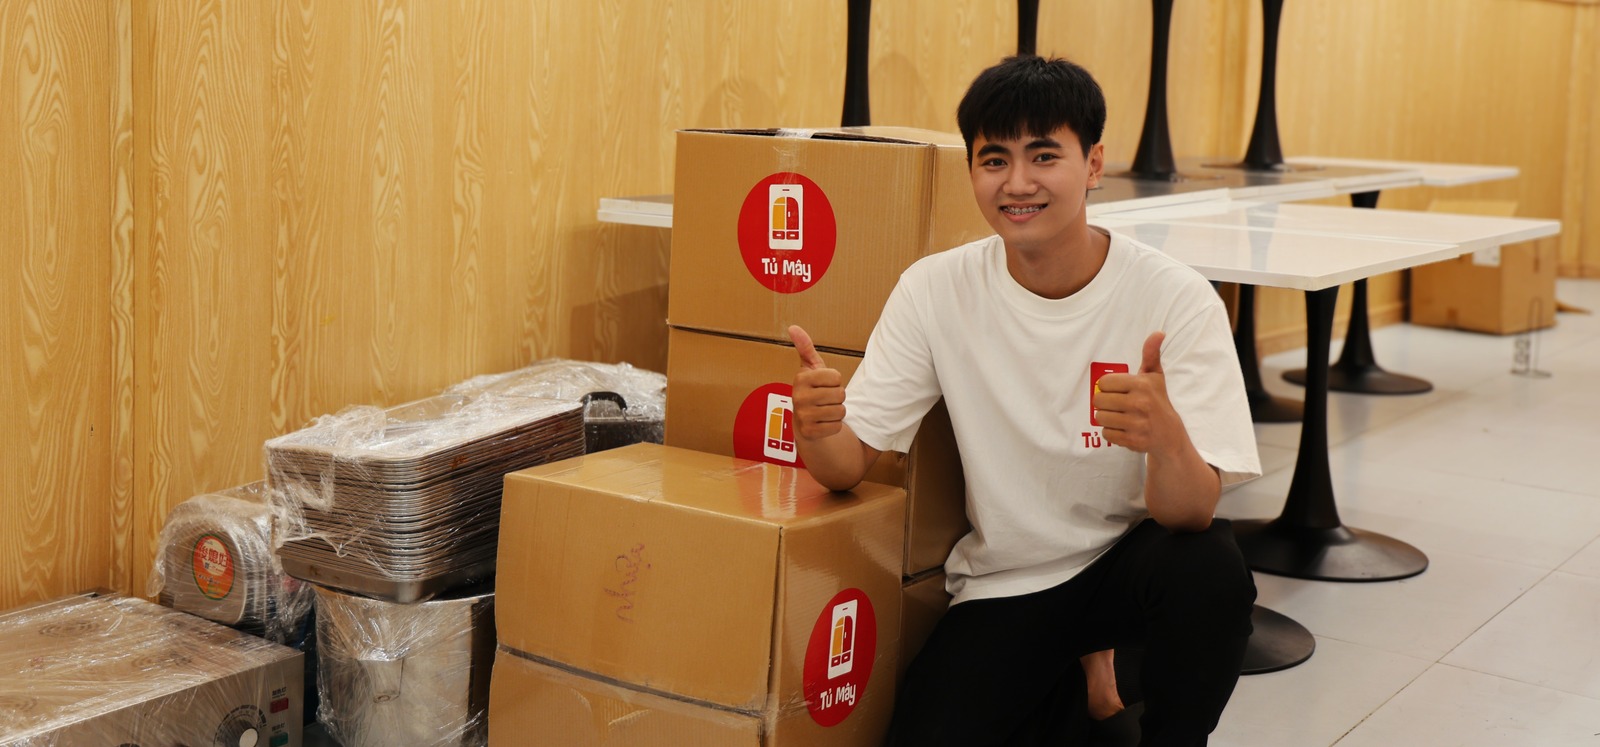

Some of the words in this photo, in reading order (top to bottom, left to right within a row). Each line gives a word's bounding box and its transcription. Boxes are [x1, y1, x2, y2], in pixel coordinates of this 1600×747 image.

[761, 257, 779, 275] Tủ
[782, 259, 812, 283] Mây
[1081, 431, 1101, 448] Tủ
[820, 687, 833, 711] Tủ
[834, 682, 857, 706] Mây
